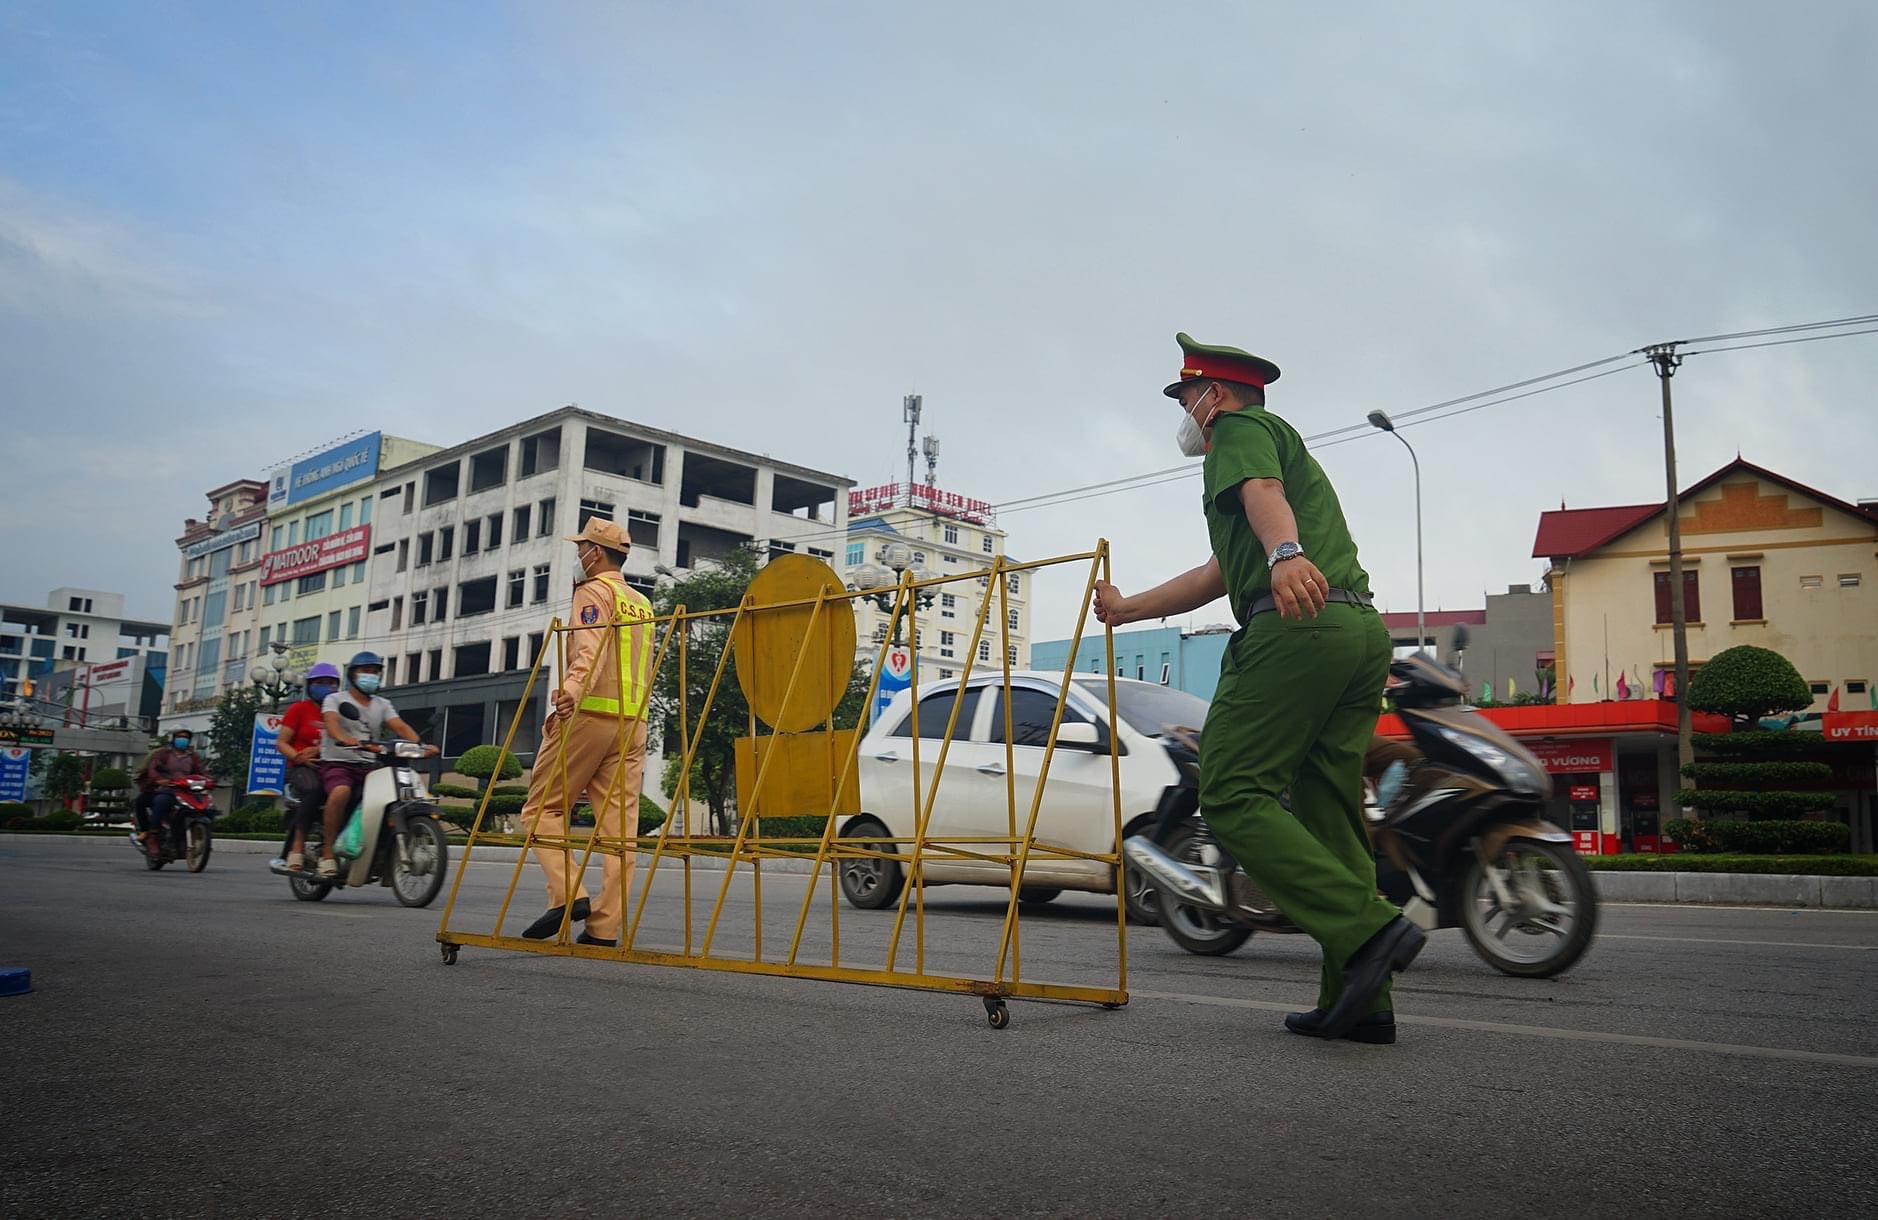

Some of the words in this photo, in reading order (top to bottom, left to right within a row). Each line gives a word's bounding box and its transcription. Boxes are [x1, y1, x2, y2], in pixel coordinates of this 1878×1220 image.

[273, 543, 320, 571] MATDOOR
[1831, 727, 1851, 737] UY
[1551, 755, 1600, 766] VƯƠNG
